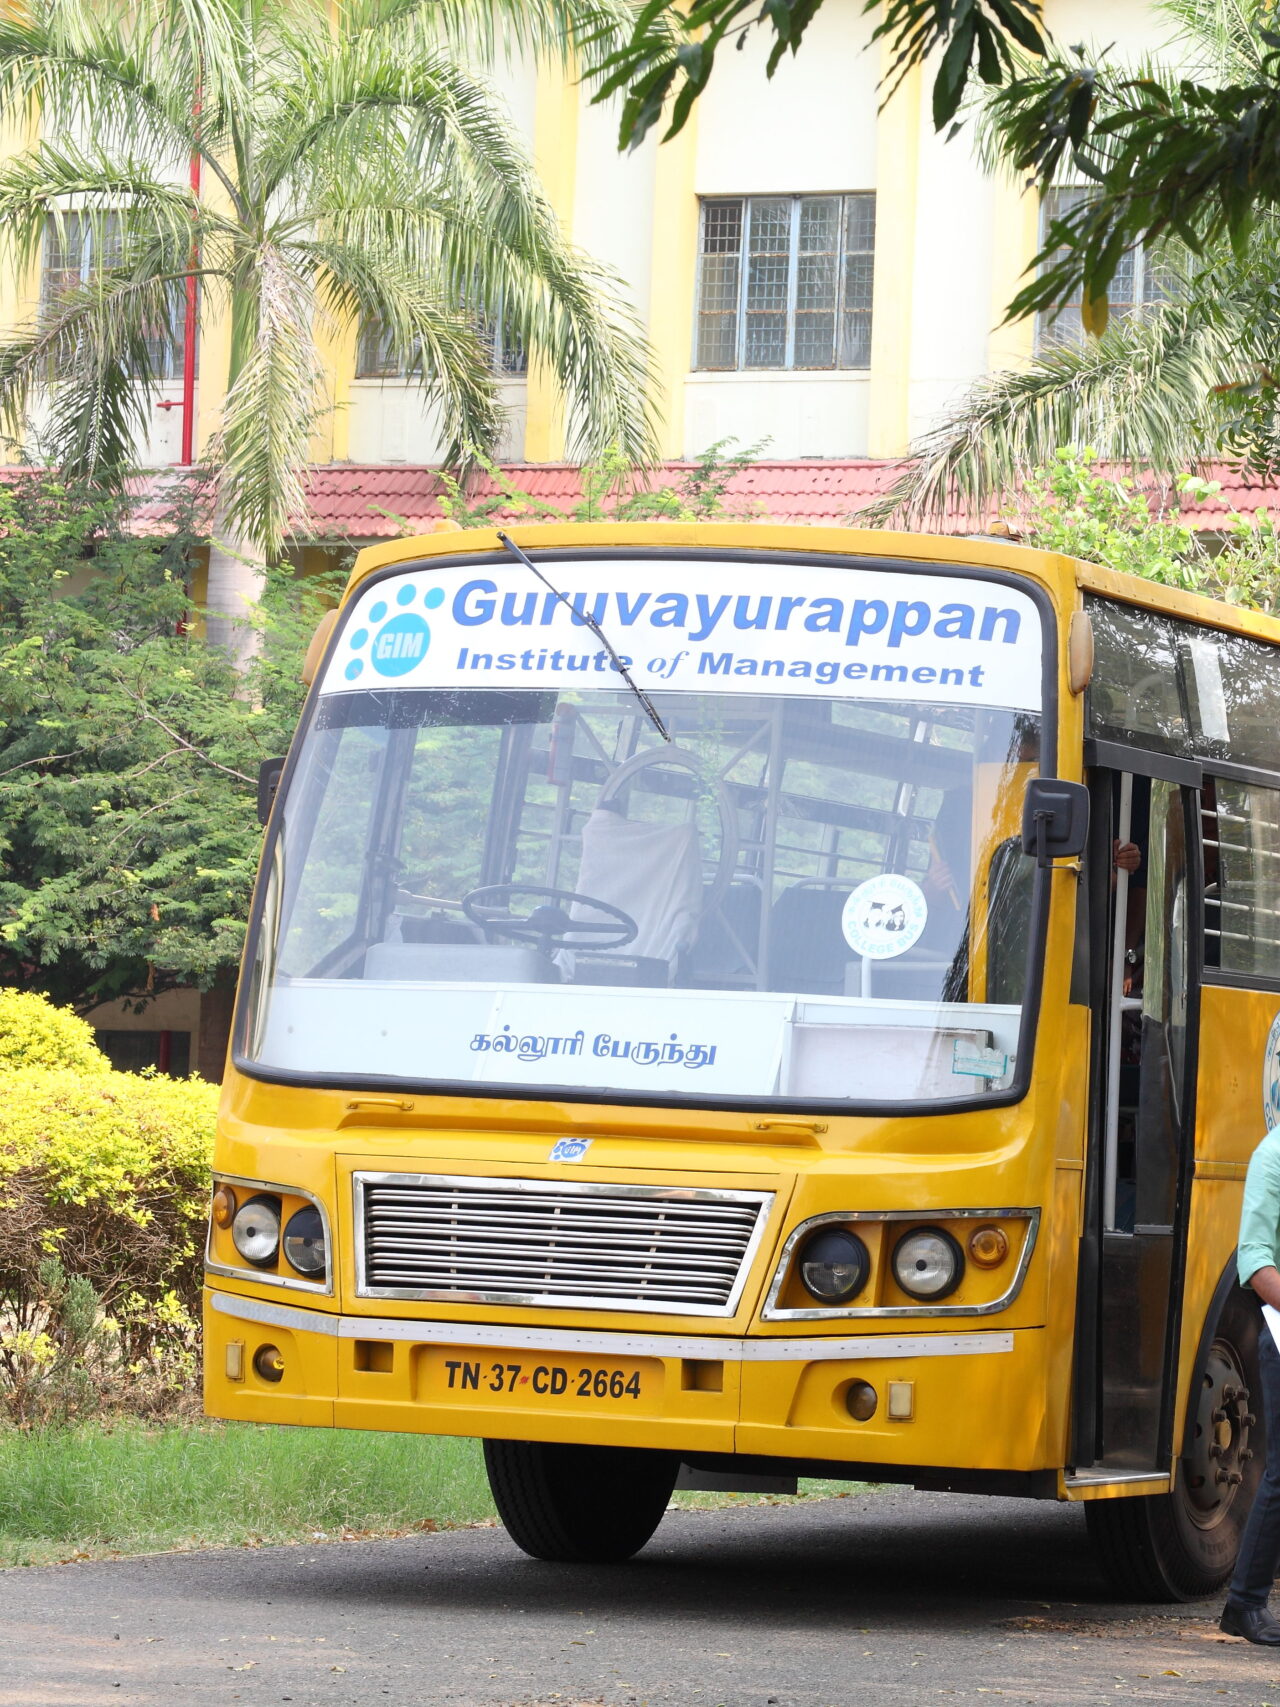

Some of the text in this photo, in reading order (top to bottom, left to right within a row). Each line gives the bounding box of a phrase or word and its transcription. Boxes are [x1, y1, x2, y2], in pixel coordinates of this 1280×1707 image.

[452, 579, 1022, 648] Guruvayurappan
[376, 631, 425, 660] GIM
[456, 647, 985, 688] Institute of Management
[848, 920, 919, 954] COLLEGE BUS
[469, 1024, 718, 1070] கல்லூரி பேருந்து
[445, 1360, 641, 1399] TN 37 CD 2664
